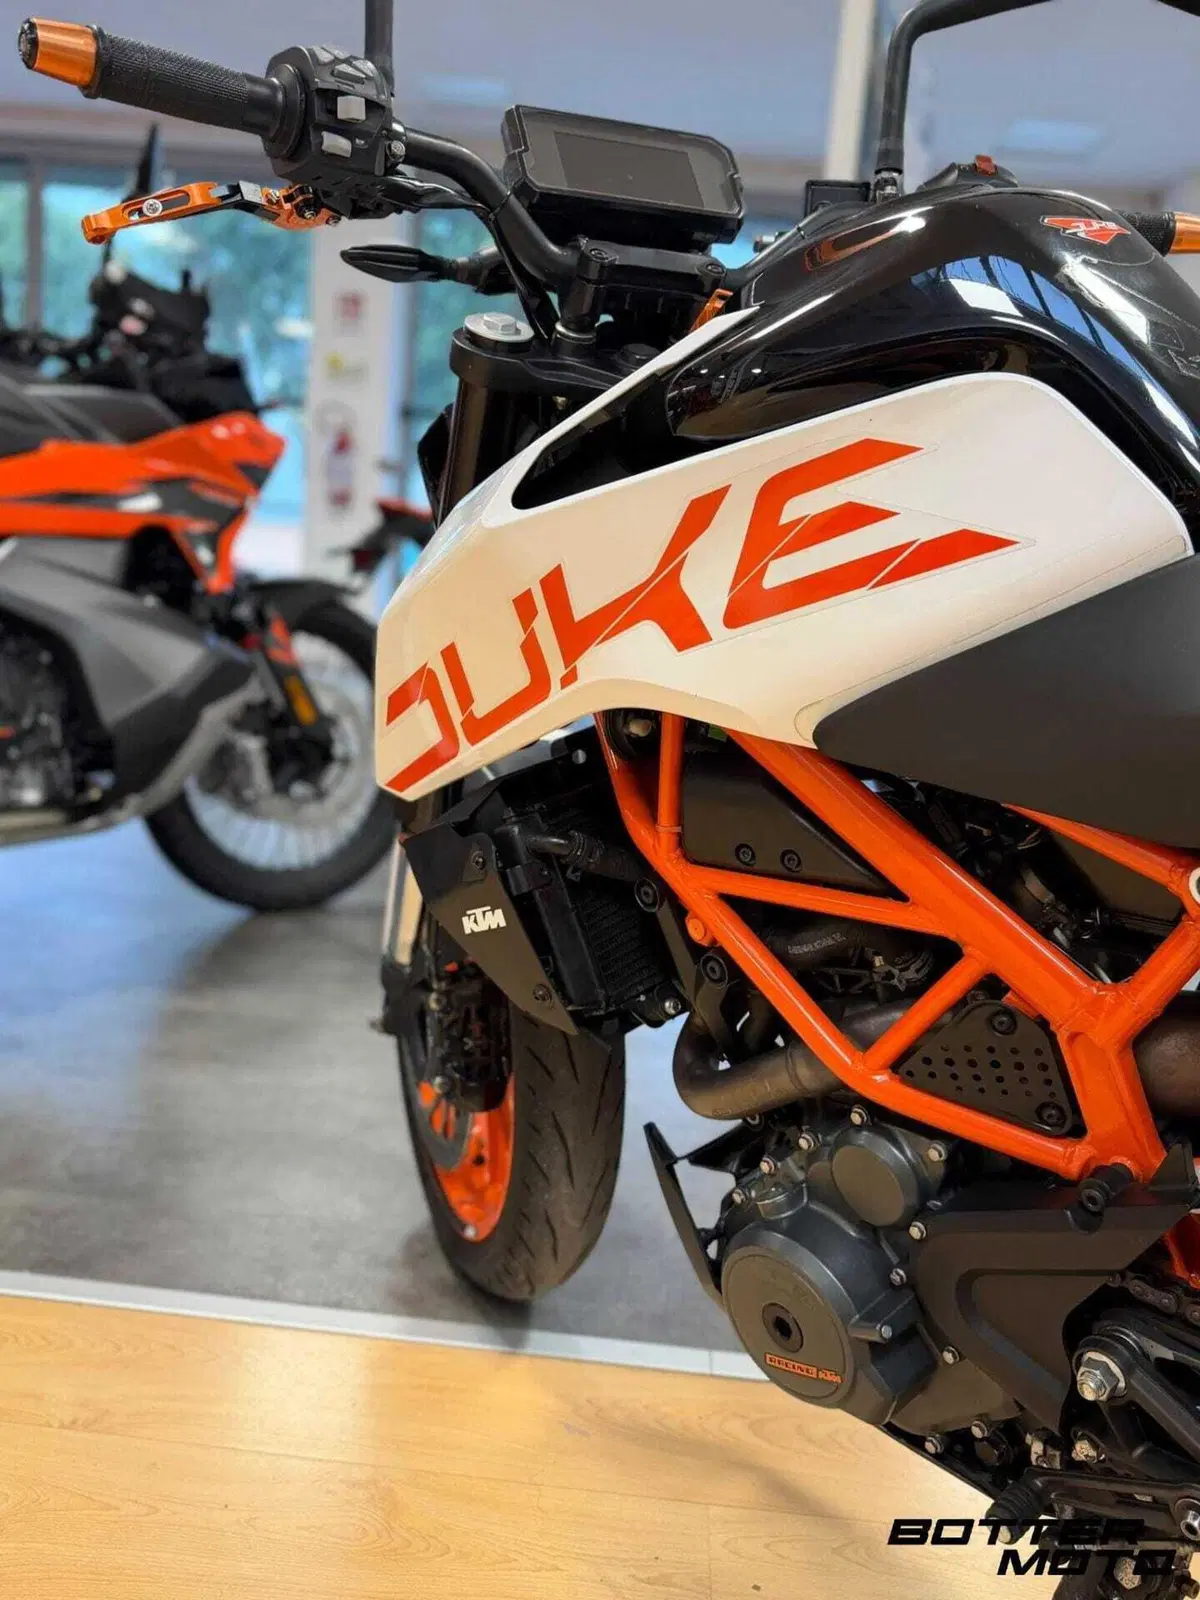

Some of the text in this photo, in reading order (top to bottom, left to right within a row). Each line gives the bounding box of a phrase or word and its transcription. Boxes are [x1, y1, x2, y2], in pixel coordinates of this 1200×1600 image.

[385, 438, 1020, 793] DUKE
[462, 905, 507, 935] KTM
[767, 1355, 816, 1377] RACING
